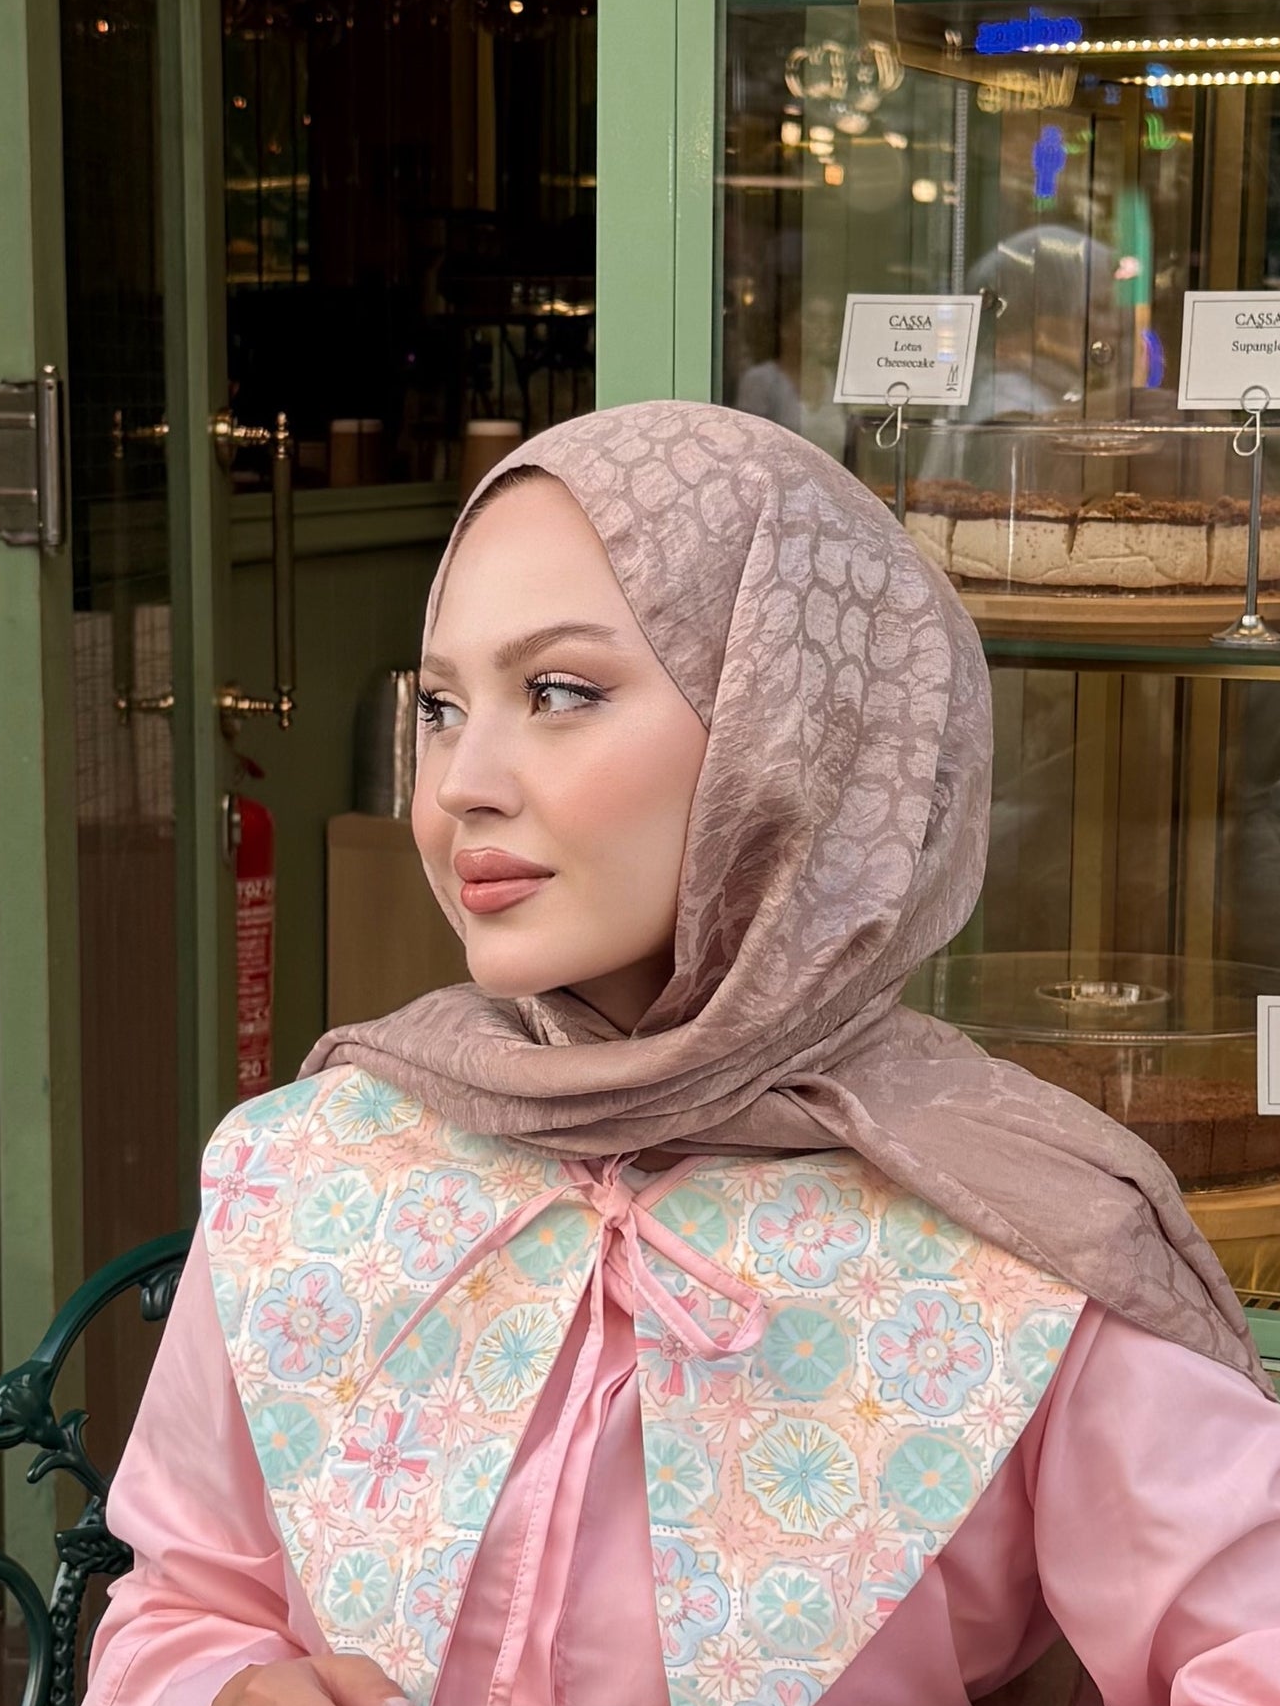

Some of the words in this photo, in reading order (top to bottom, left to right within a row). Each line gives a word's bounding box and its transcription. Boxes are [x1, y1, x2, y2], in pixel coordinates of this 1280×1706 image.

[889, 315, 932, 330] CASSA
[894, 341, 922, 352] Lotus
[876, 356, 935, 368] Cheesecake
